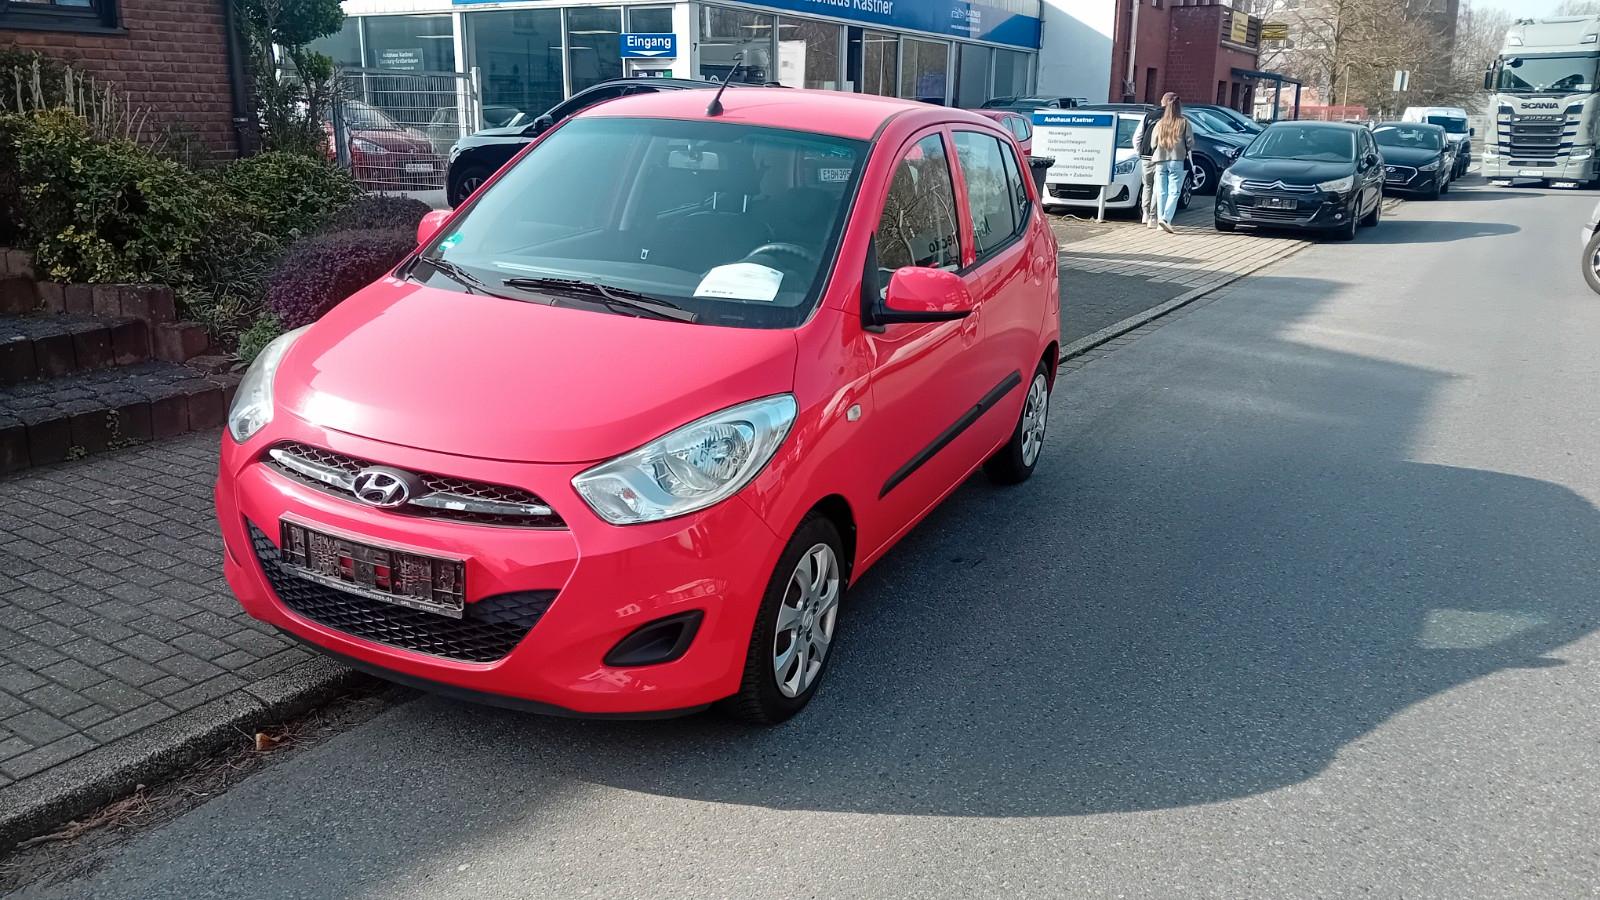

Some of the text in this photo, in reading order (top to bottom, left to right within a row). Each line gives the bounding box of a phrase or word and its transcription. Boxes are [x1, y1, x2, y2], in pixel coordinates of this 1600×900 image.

[853, 0, 893, 15] Kastner
[626, 35, 672, 49] Eingang
[692, 42, 698, 52] 7
